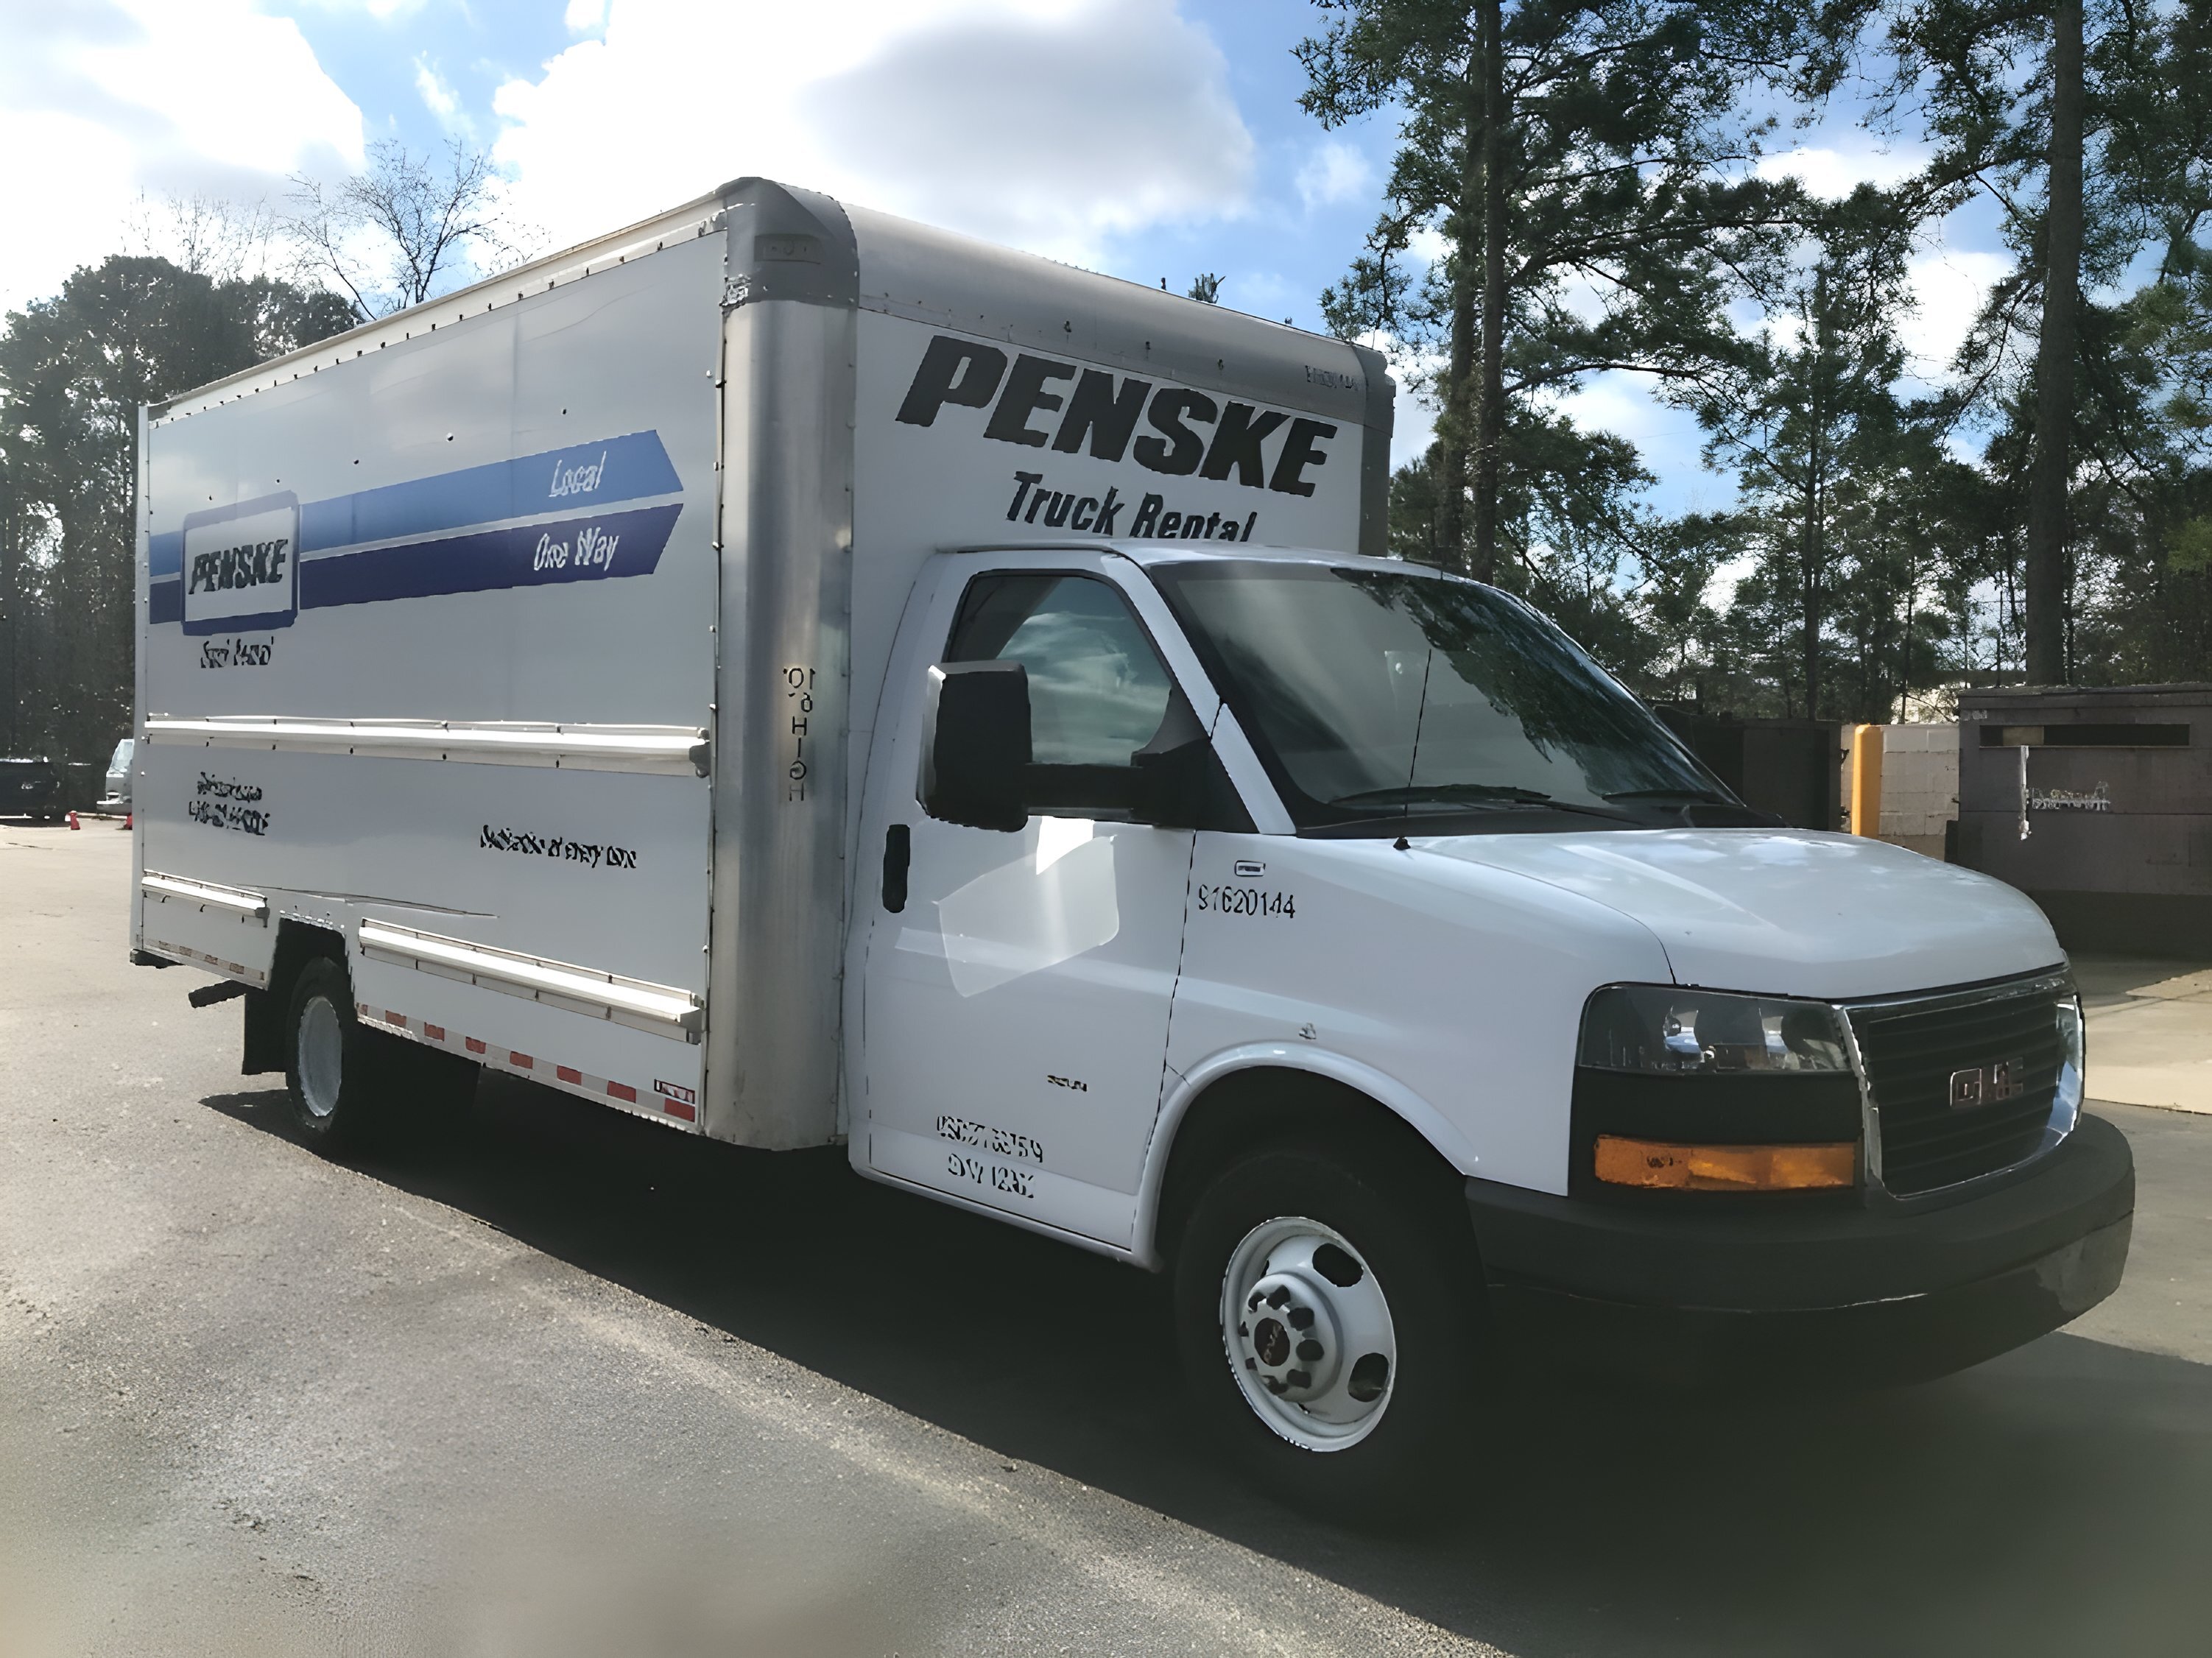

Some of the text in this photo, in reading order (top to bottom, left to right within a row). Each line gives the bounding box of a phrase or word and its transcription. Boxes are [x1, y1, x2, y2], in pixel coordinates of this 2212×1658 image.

[895, 335, 1337, 498] PENSKE
[549, 451, 606, 497] Local
[1006, 470, 1258, 543] Truck Rental
[189, 539, 288, 595] PENSKE
[574, 526, 619, 571] Way
